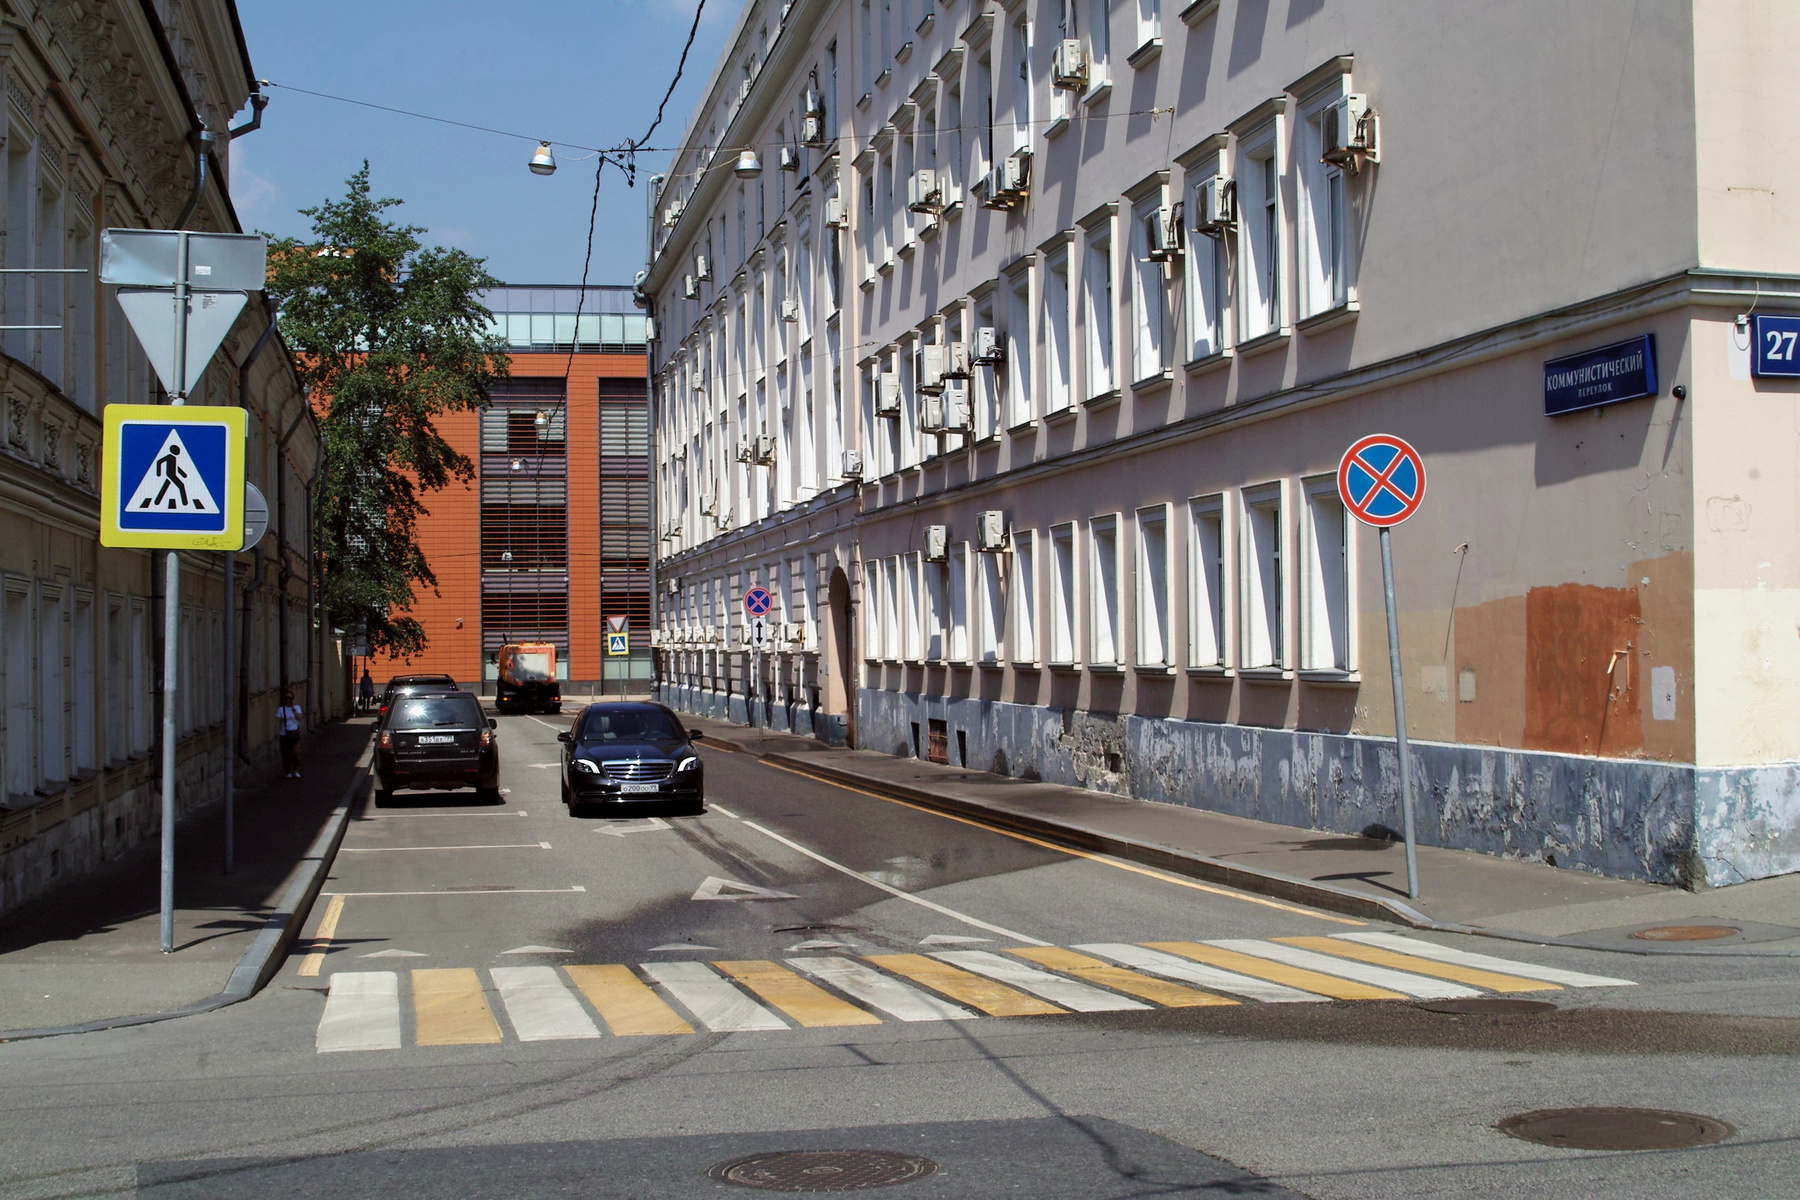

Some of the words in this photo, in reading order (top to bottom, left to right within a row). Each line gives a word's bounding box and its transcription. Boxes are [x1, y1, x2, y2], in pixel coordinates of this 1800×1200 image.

[1766, 330, 1799, 361] 27
[1546, 350, 1643, 391] КОММУНИСТИЧЕСКИЙ
[1578, 382, 1613, 398] ПЕРЕУЛОК
